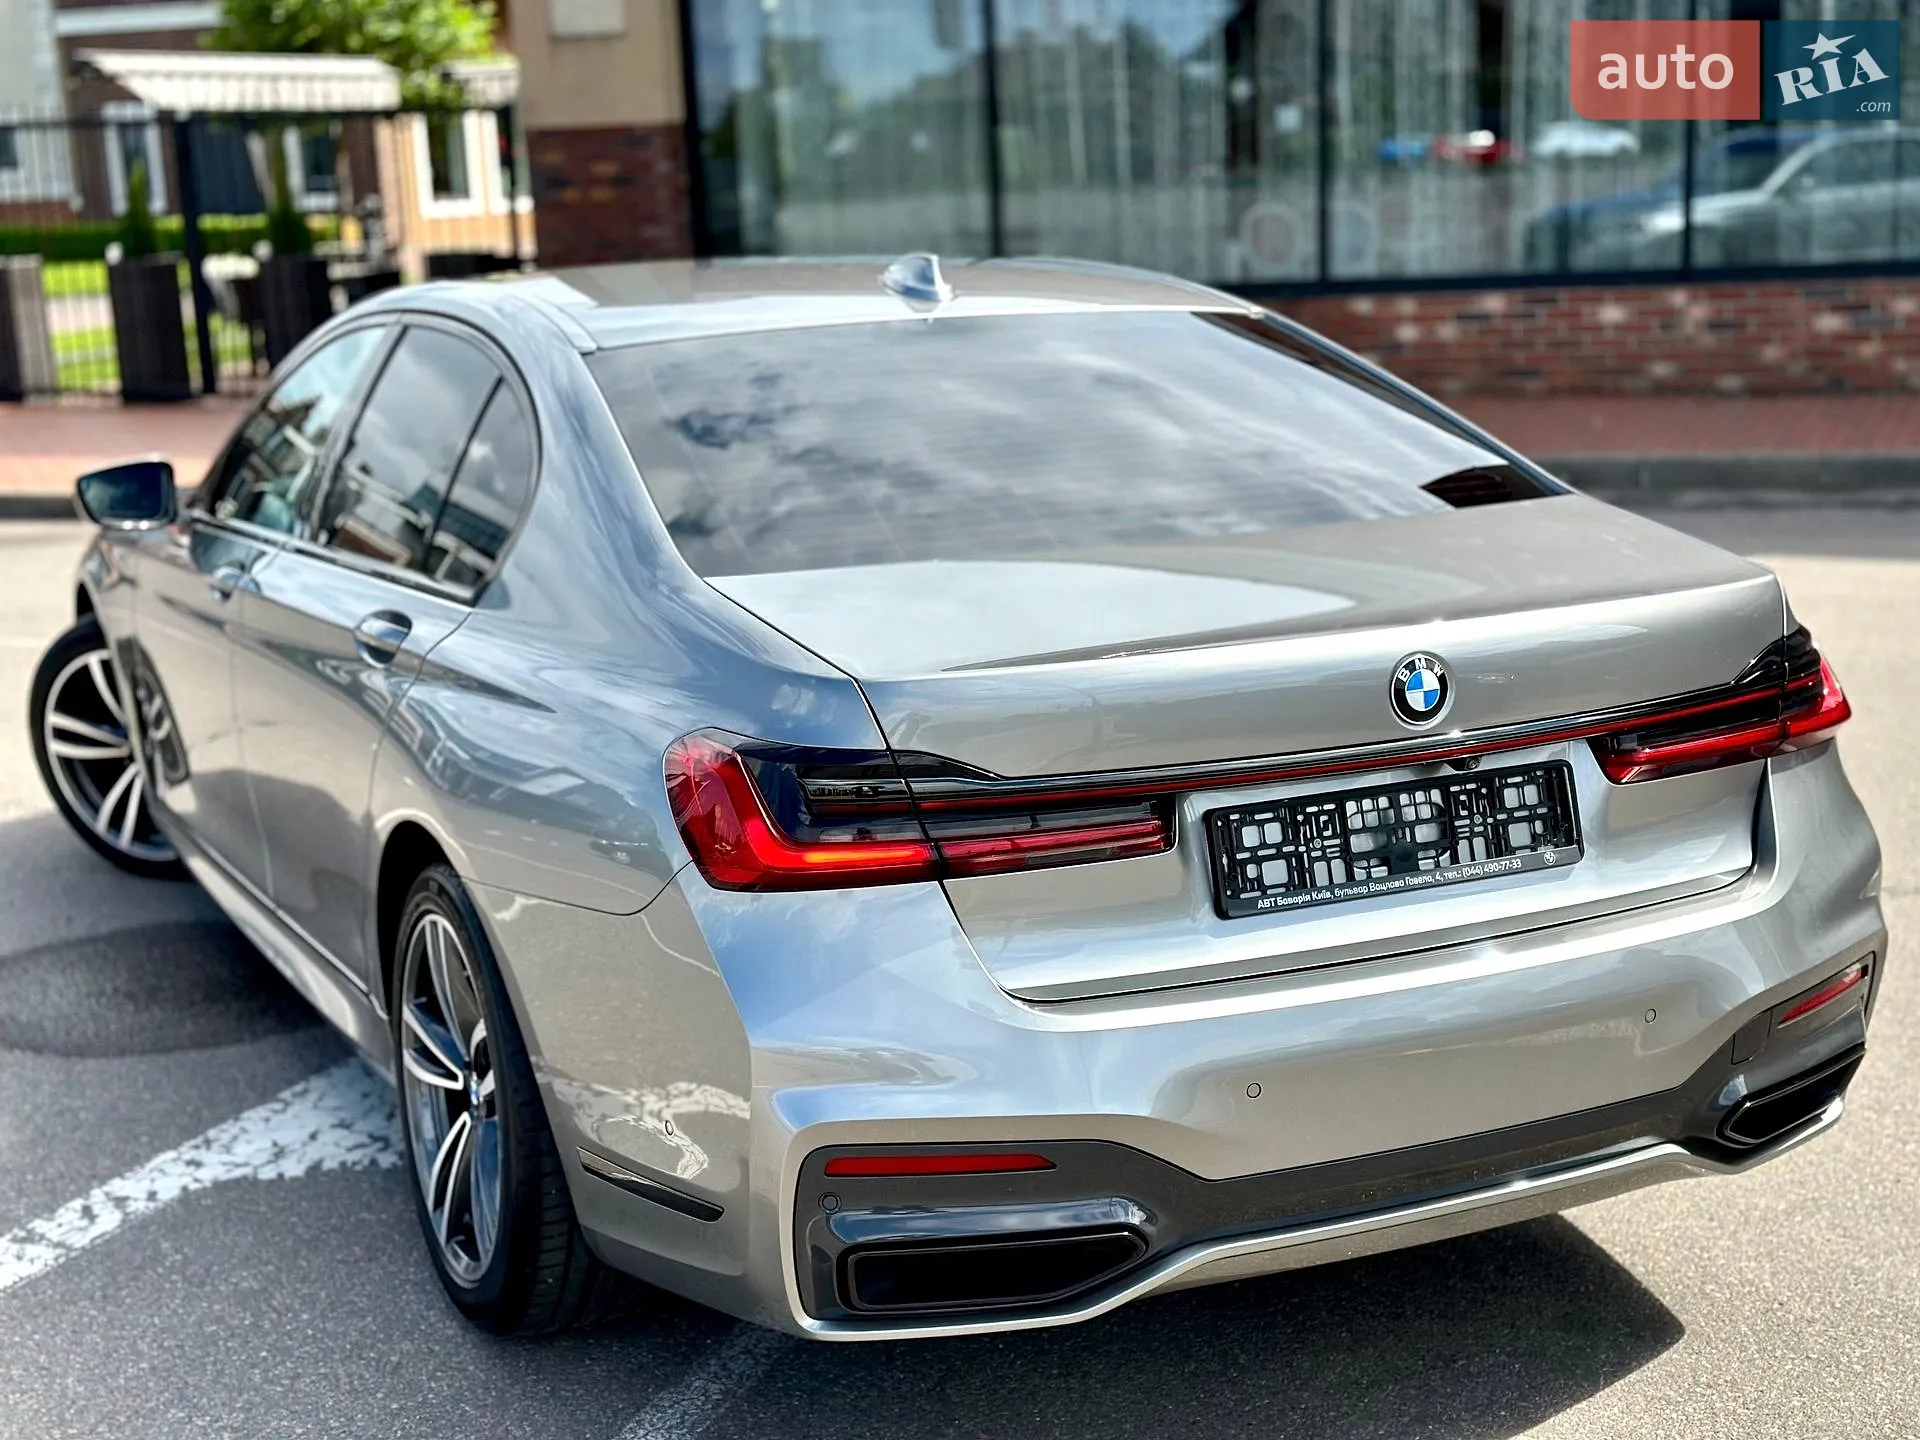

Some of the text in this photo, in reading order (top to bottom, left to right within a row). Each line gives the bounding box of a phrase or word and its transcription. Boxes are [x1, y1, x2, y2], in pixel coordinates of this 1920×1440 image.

[1397, 657, 1445, 683] BMW
[1257, 858, 1522, 909] АВТ Баварія Київ, бульвар Вацлава Гавела, 4, тел.: (044) 490-77-33
